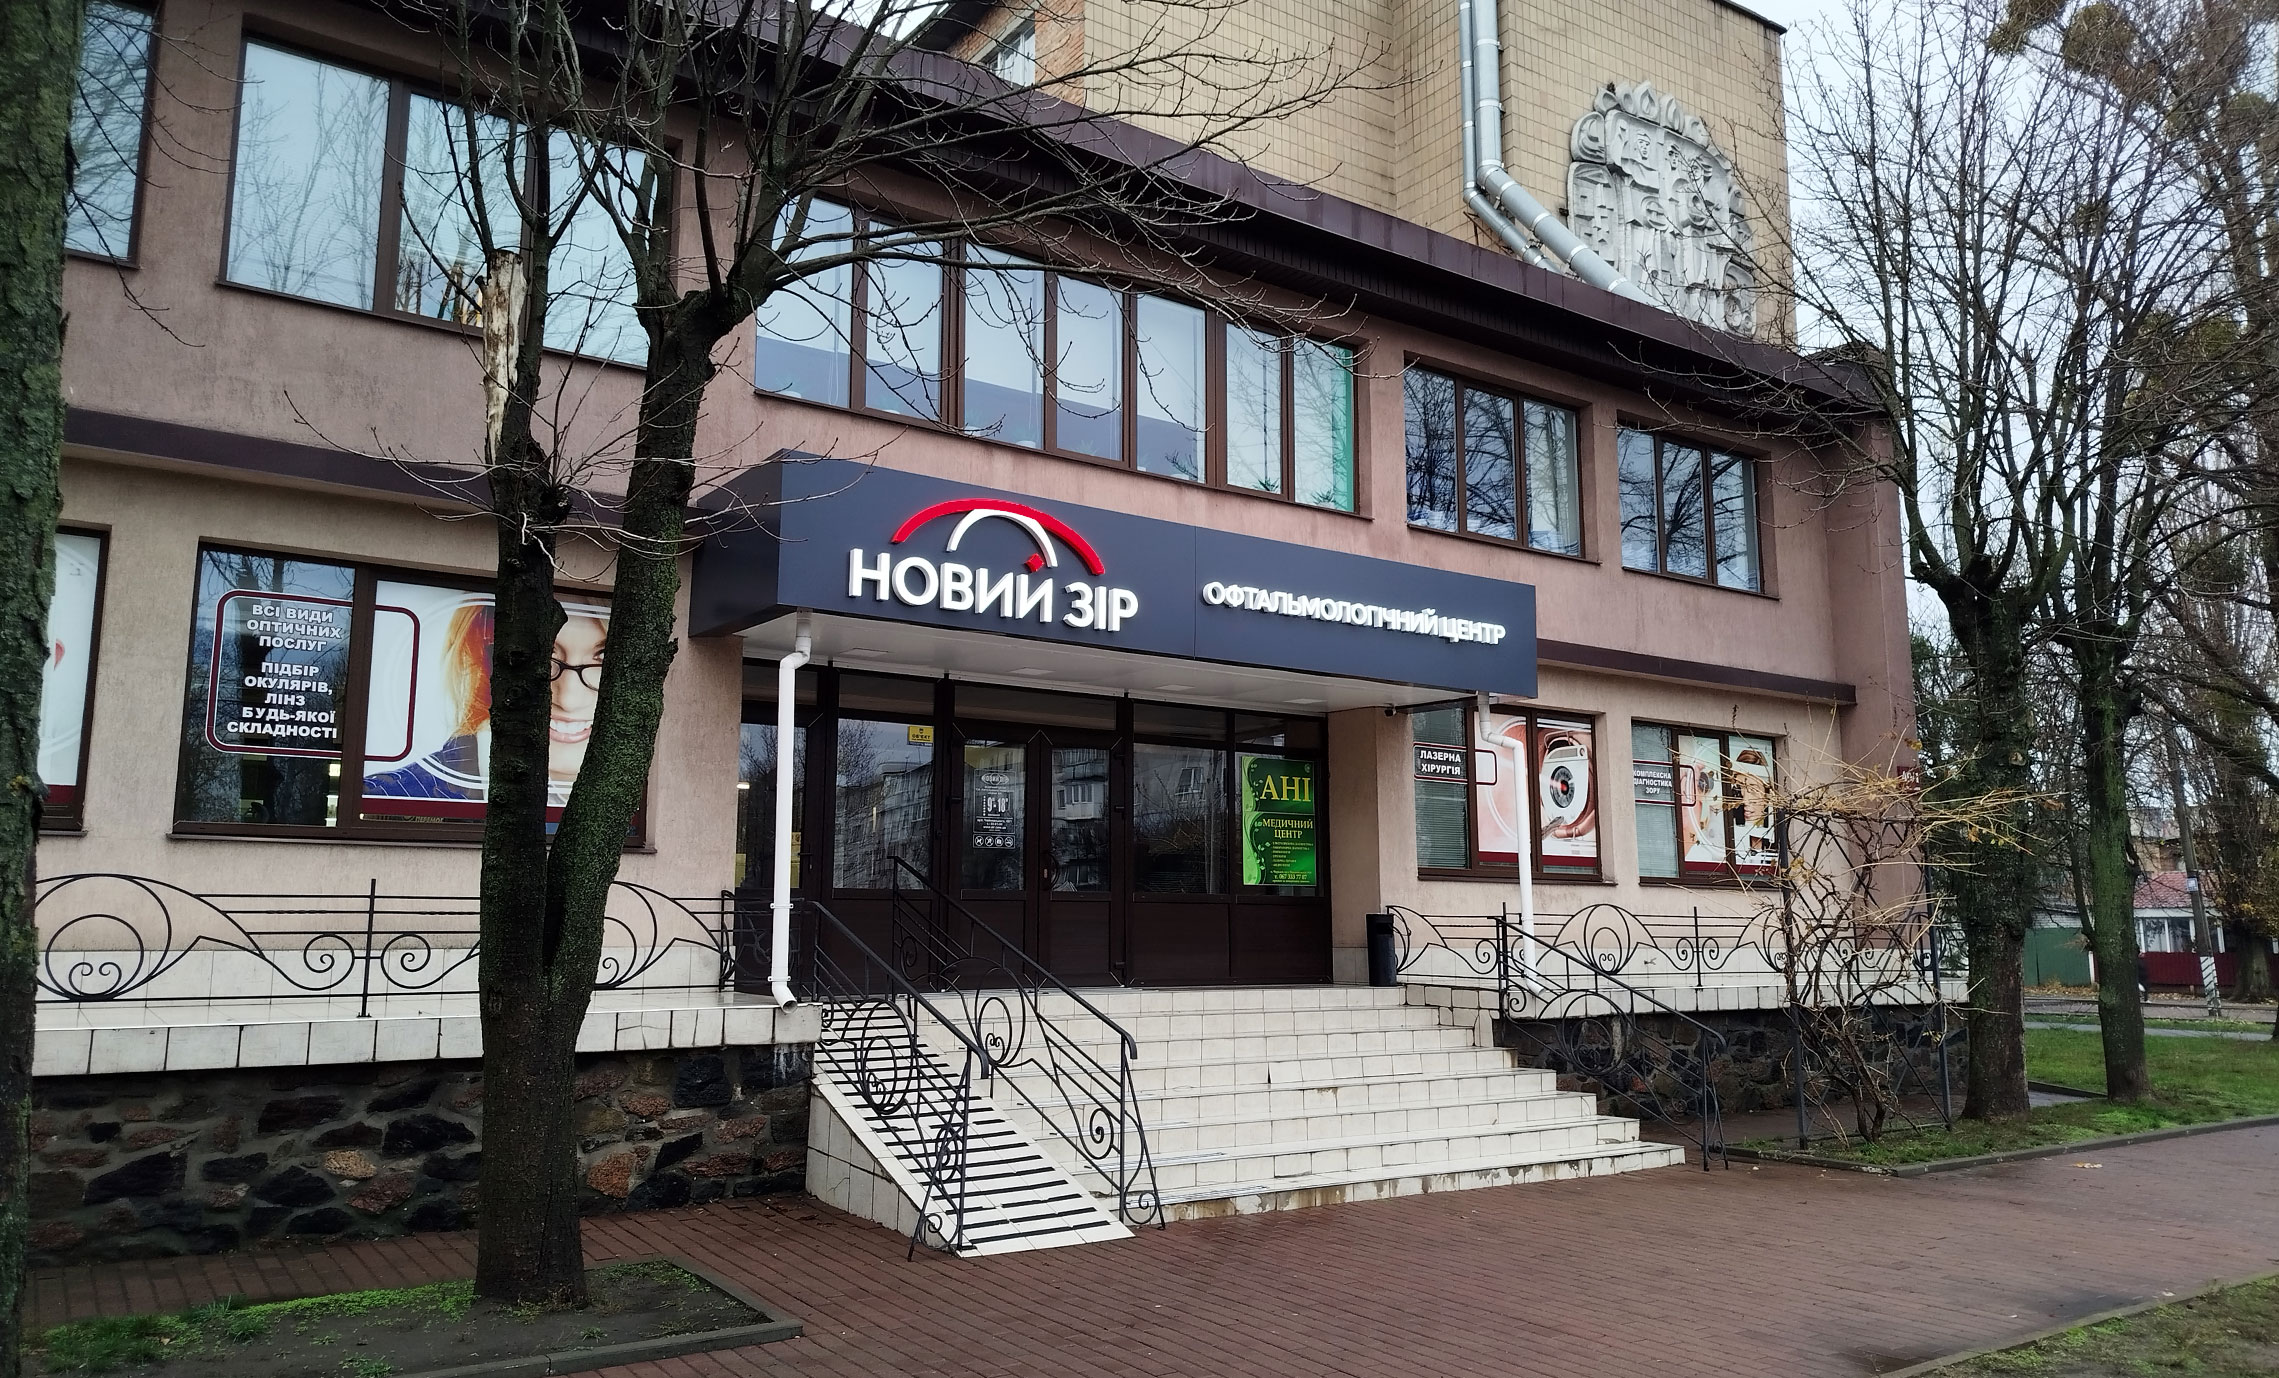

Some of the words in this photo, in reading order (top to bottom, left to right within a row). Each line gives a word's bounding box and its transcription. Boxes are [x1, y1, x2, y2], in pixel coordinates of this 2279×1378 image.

[849, 548, 1053, 623] НОВИЙ
[1063, 582, 1139, 631] ЗІР
[252, 604, 280, 617] ВСІ
[286, 608, 333, 623] ВИДИ
[1202, 581, 1440, 637] ОФТАЛЬМОЛОГІЧНИЙ
[1439, 616, 1506, 645] ЦЕНТР
[246, 619, 342, 638] ОПТИЧНИХ
[259, 635, 327, 651] ПОСЛУГ
[261, 661, 320, 677] ПІДБІР
[244, 675, 333, 695] ОКУЛЯРІВ,
[264, 692, 306, 706] ЛІНЗ
[242, 706, 336, 723] БУДЬ-ЯКОЇ
[226, 721, 337, 739] СКЛАДНОСТІ
[1420, 750, 1461, 763] ЛАЗЕРНА
[1421, 763, 1461, 776] ХІРУРГІЯ
[1260, 775, 1312, 802] АНІ
[1645, 786, 1661, 795] ЗОРУ
[1262, 818, 1314, 830] МЕДИЧНИЙ
[1274, 829, 1303, 839] ЦЕНТР
